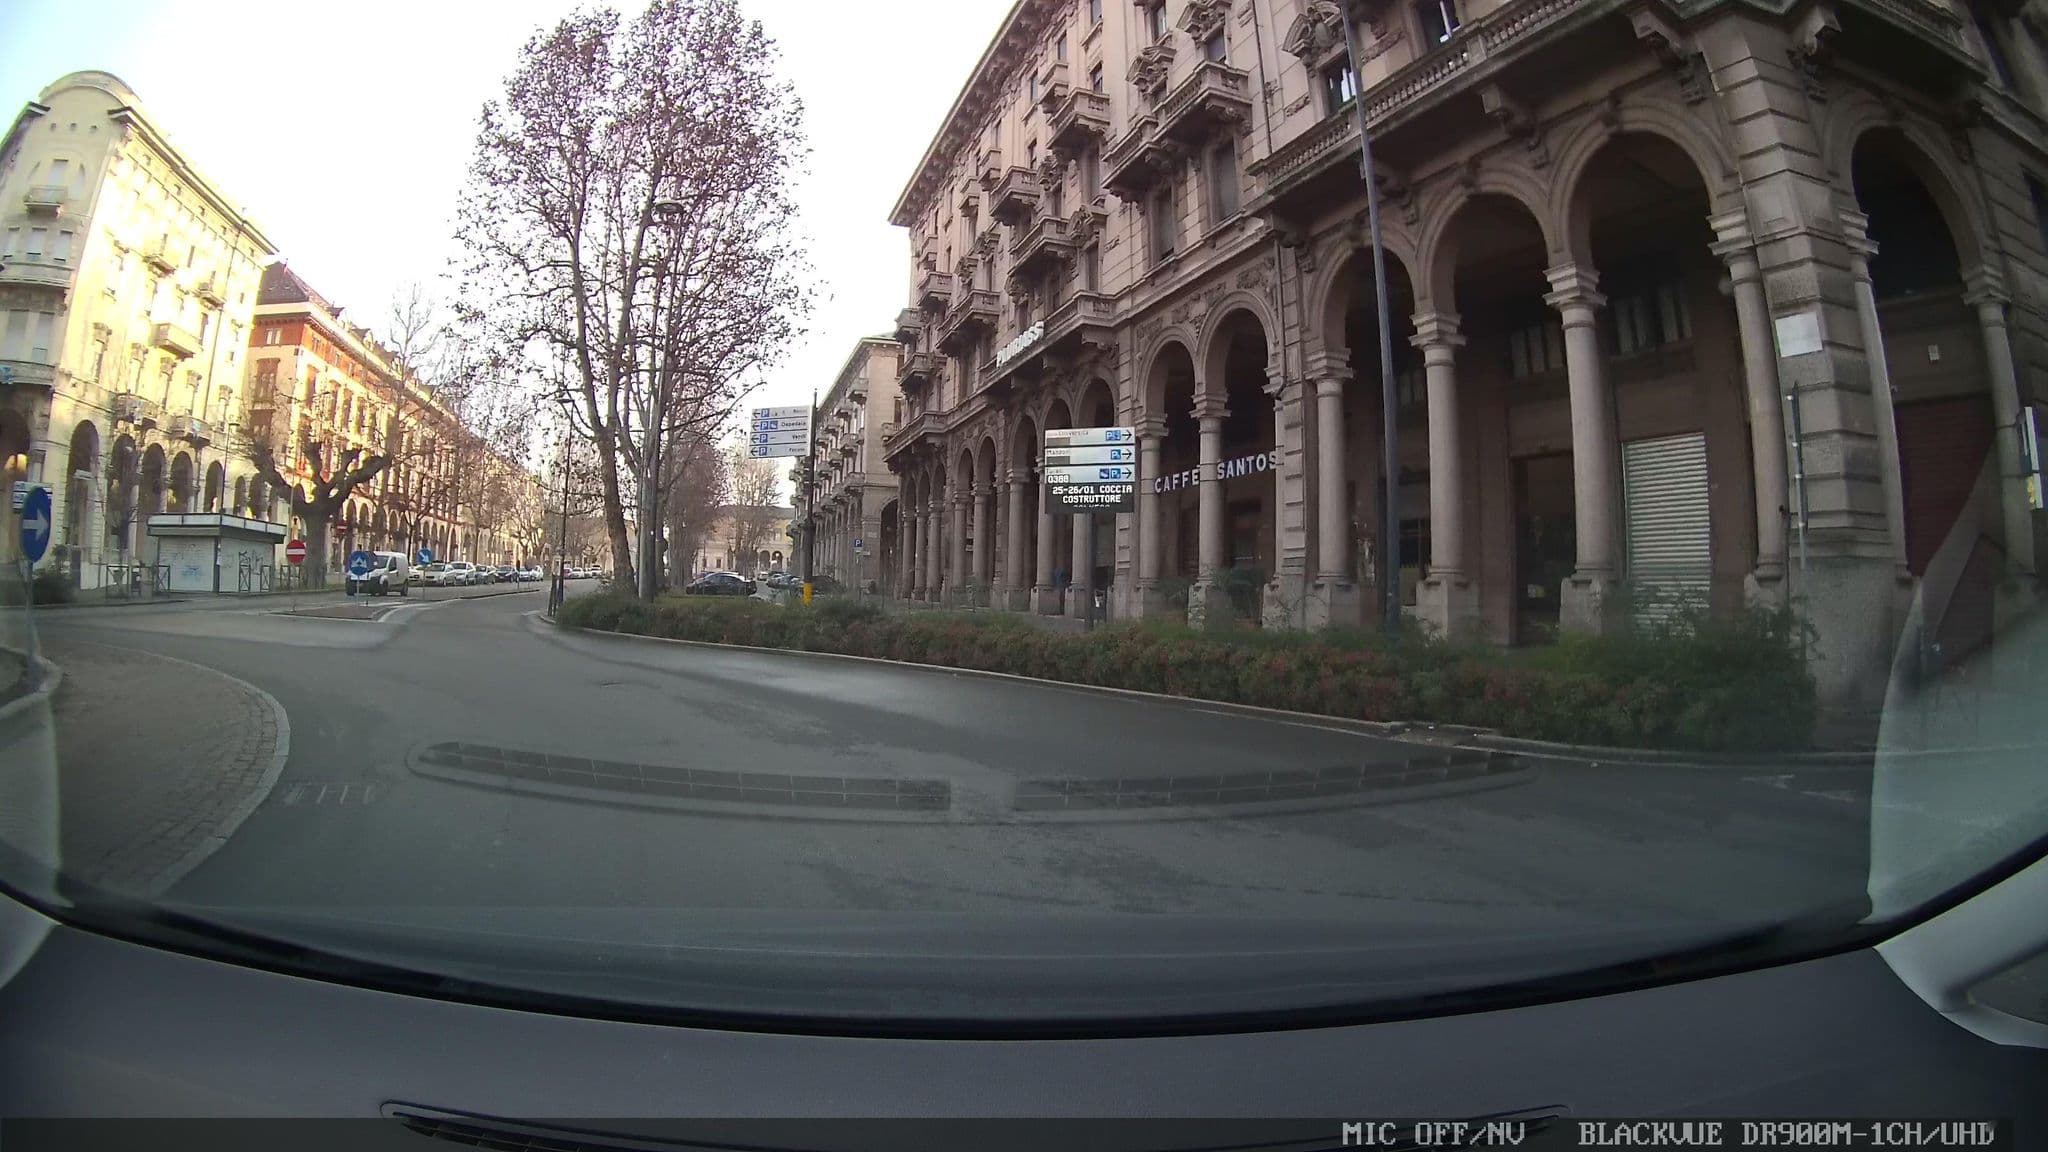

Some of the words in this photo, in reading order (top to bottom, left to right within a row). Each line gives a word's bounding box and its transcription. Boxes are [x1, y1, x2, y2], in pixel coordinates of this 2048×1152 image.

[1217, 451, 1277, 480] SANTOS
[1052, 486, 1094, 495] 25-26/01
[1099, 485, 1132, 494] COCCIA
[1062, 495, 1121, 503] COSTRUTTORE
